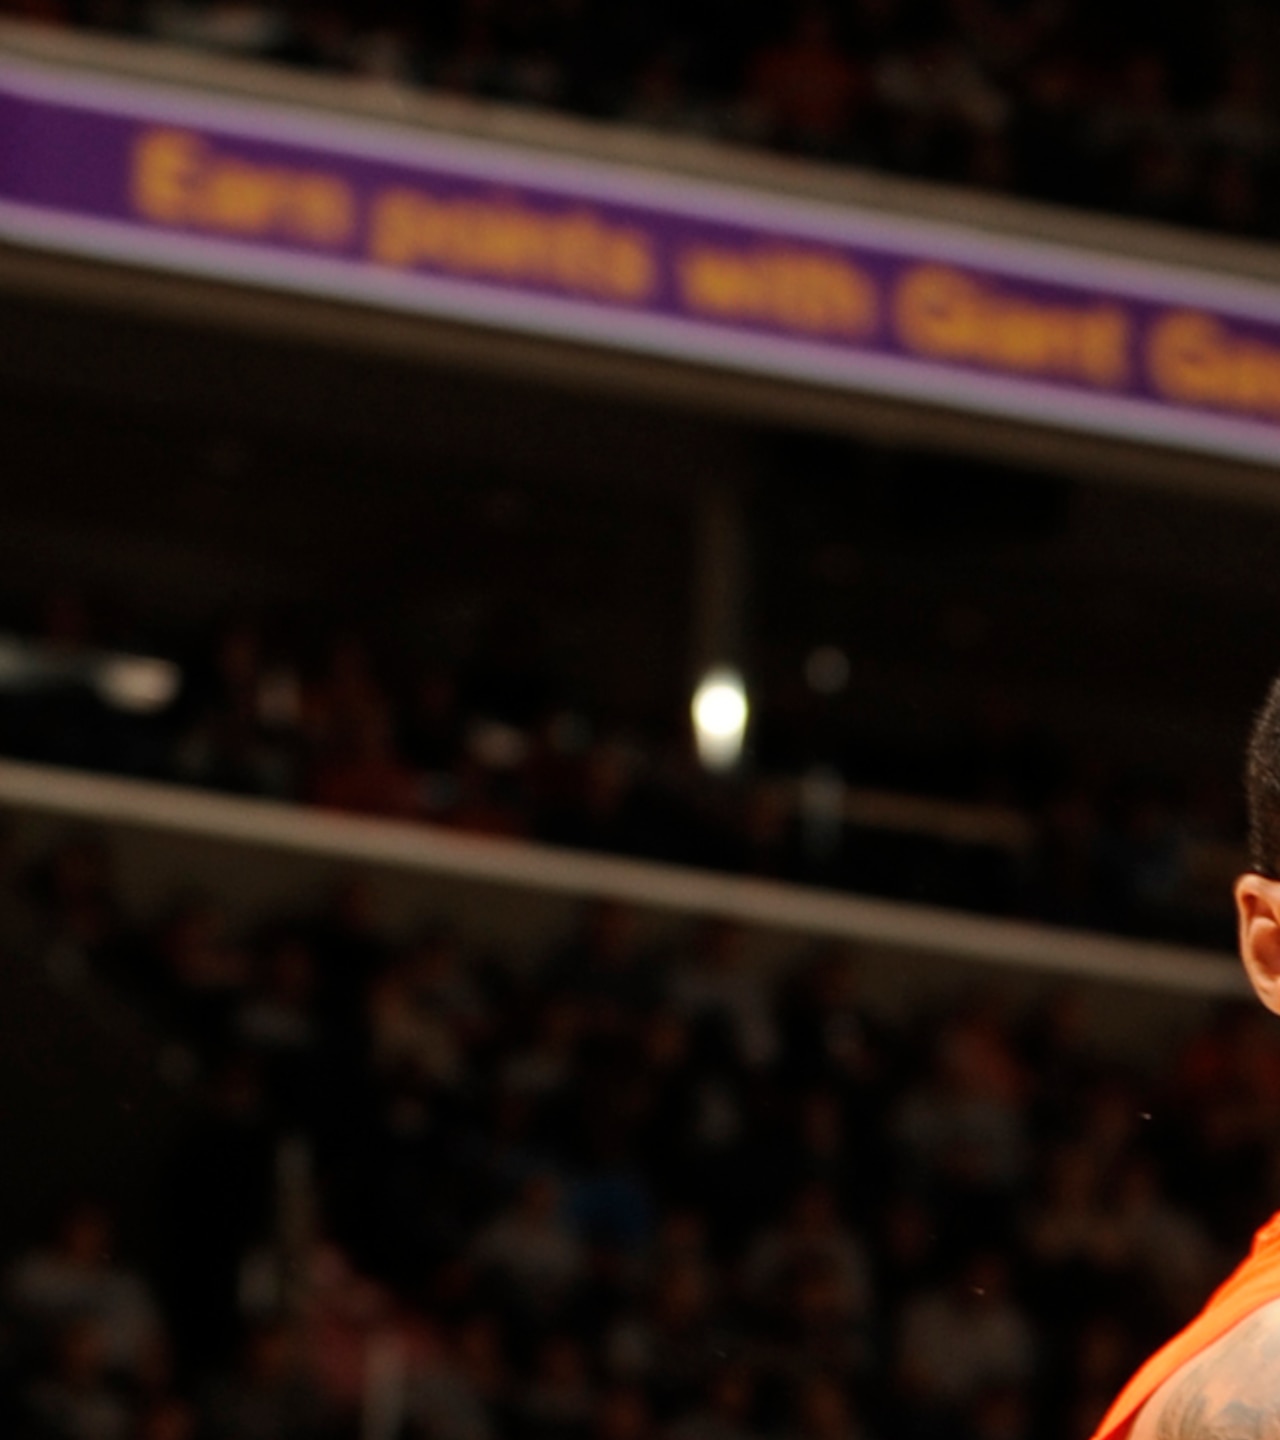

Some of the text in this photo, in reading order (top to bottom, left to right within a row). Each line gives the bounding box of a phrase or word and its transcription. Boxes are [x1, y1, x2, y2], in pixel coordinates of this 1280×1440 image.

[131, 127, 350, 241] Earn
[372, 187, 652, 301] points
[679, 247, 876, 335] with
